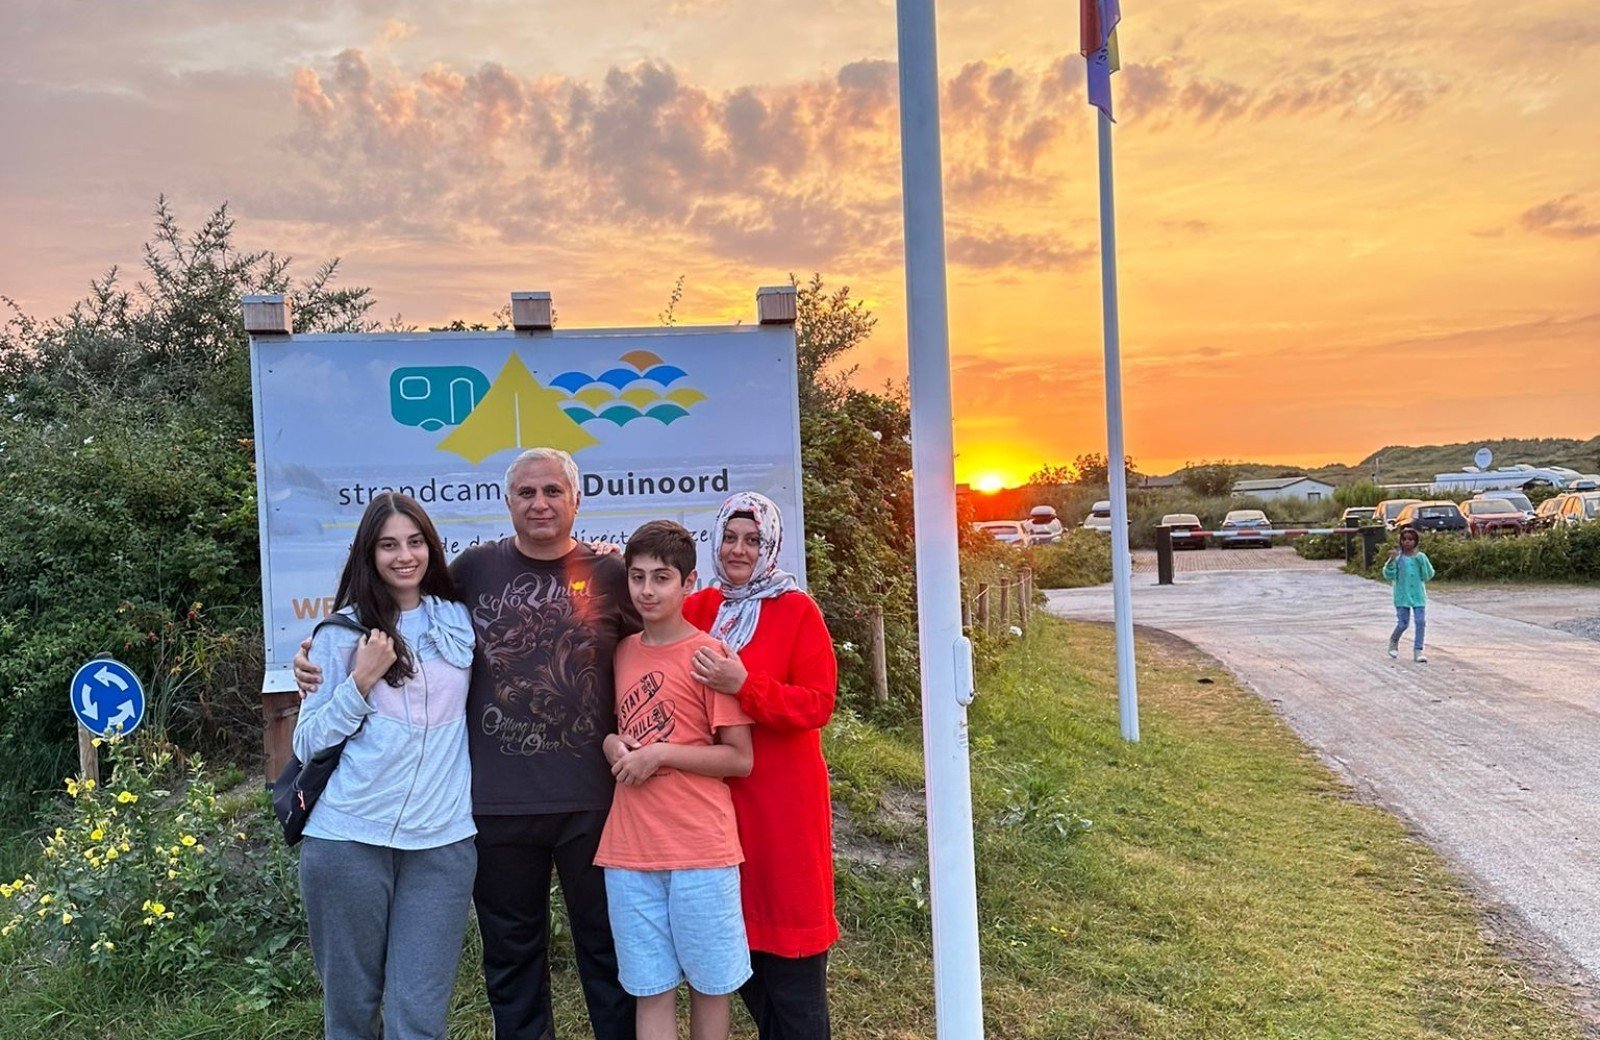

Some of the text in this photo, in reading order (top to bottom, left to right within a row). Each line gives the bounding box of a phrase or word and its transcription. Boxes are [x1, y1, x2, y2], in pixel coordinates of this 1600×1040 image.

[339, 468, 728, 505] strndcam Duinoord
[621, 688, 640, 719] STAY
